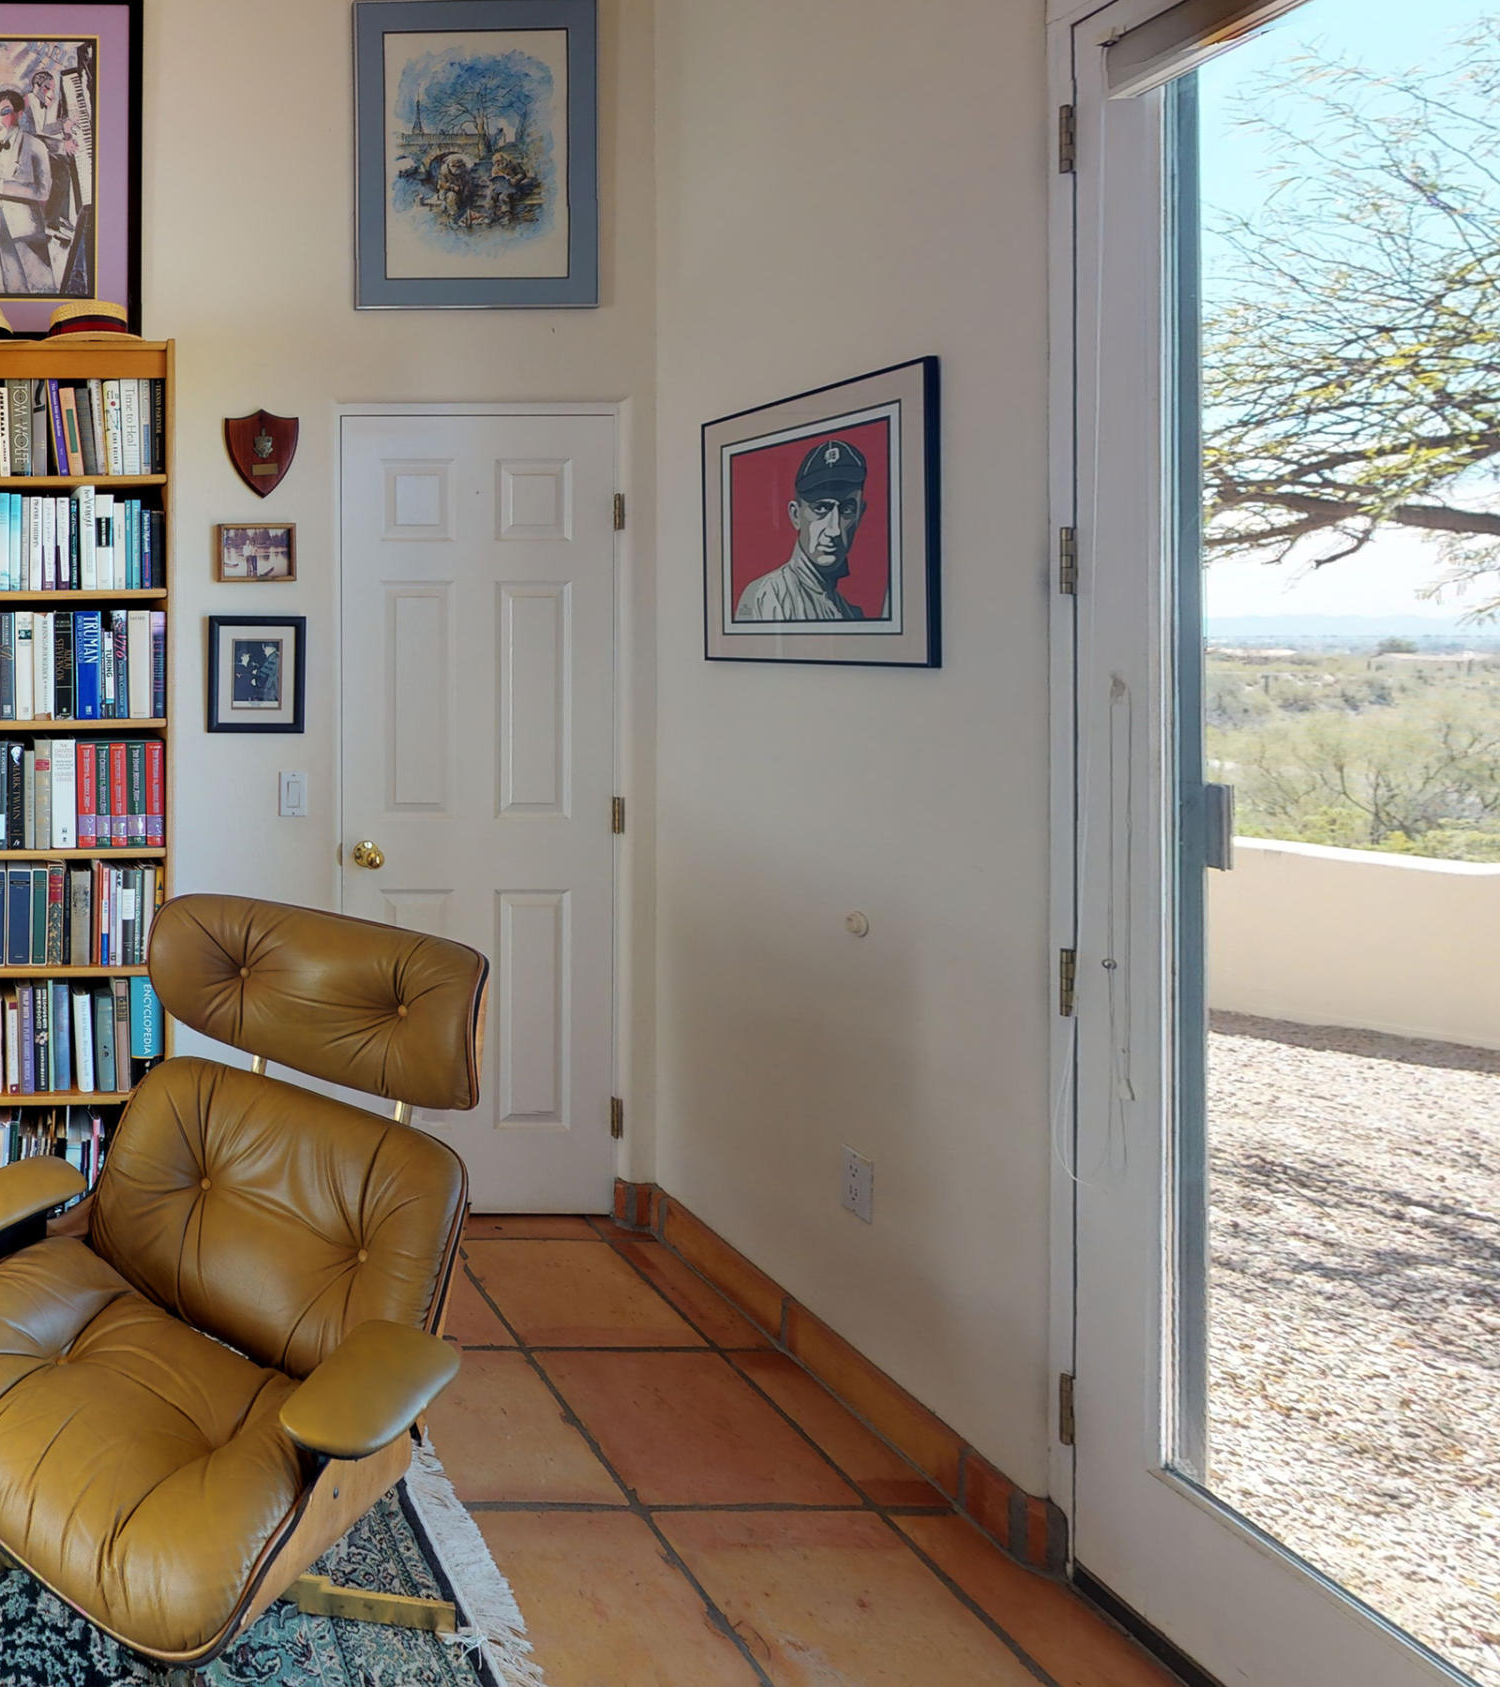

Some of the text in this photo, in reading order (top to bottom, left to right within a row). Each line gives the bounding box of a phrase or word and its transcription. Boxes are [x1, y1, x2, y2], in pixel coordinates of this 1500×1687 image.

[13, 384, 29, 464] TOM WOLFE
[125, 387, 136, 447] Time to Heal
[56, 638, 64, 681] STEVENSON
[84, 616, 98, 664] TRUMAN
[116, 634, 126, 659] 1776
[12, 763, 20, 819] MARK TWAIN
[142, 984, 152, 1055] ENCYCLOPEDIA
